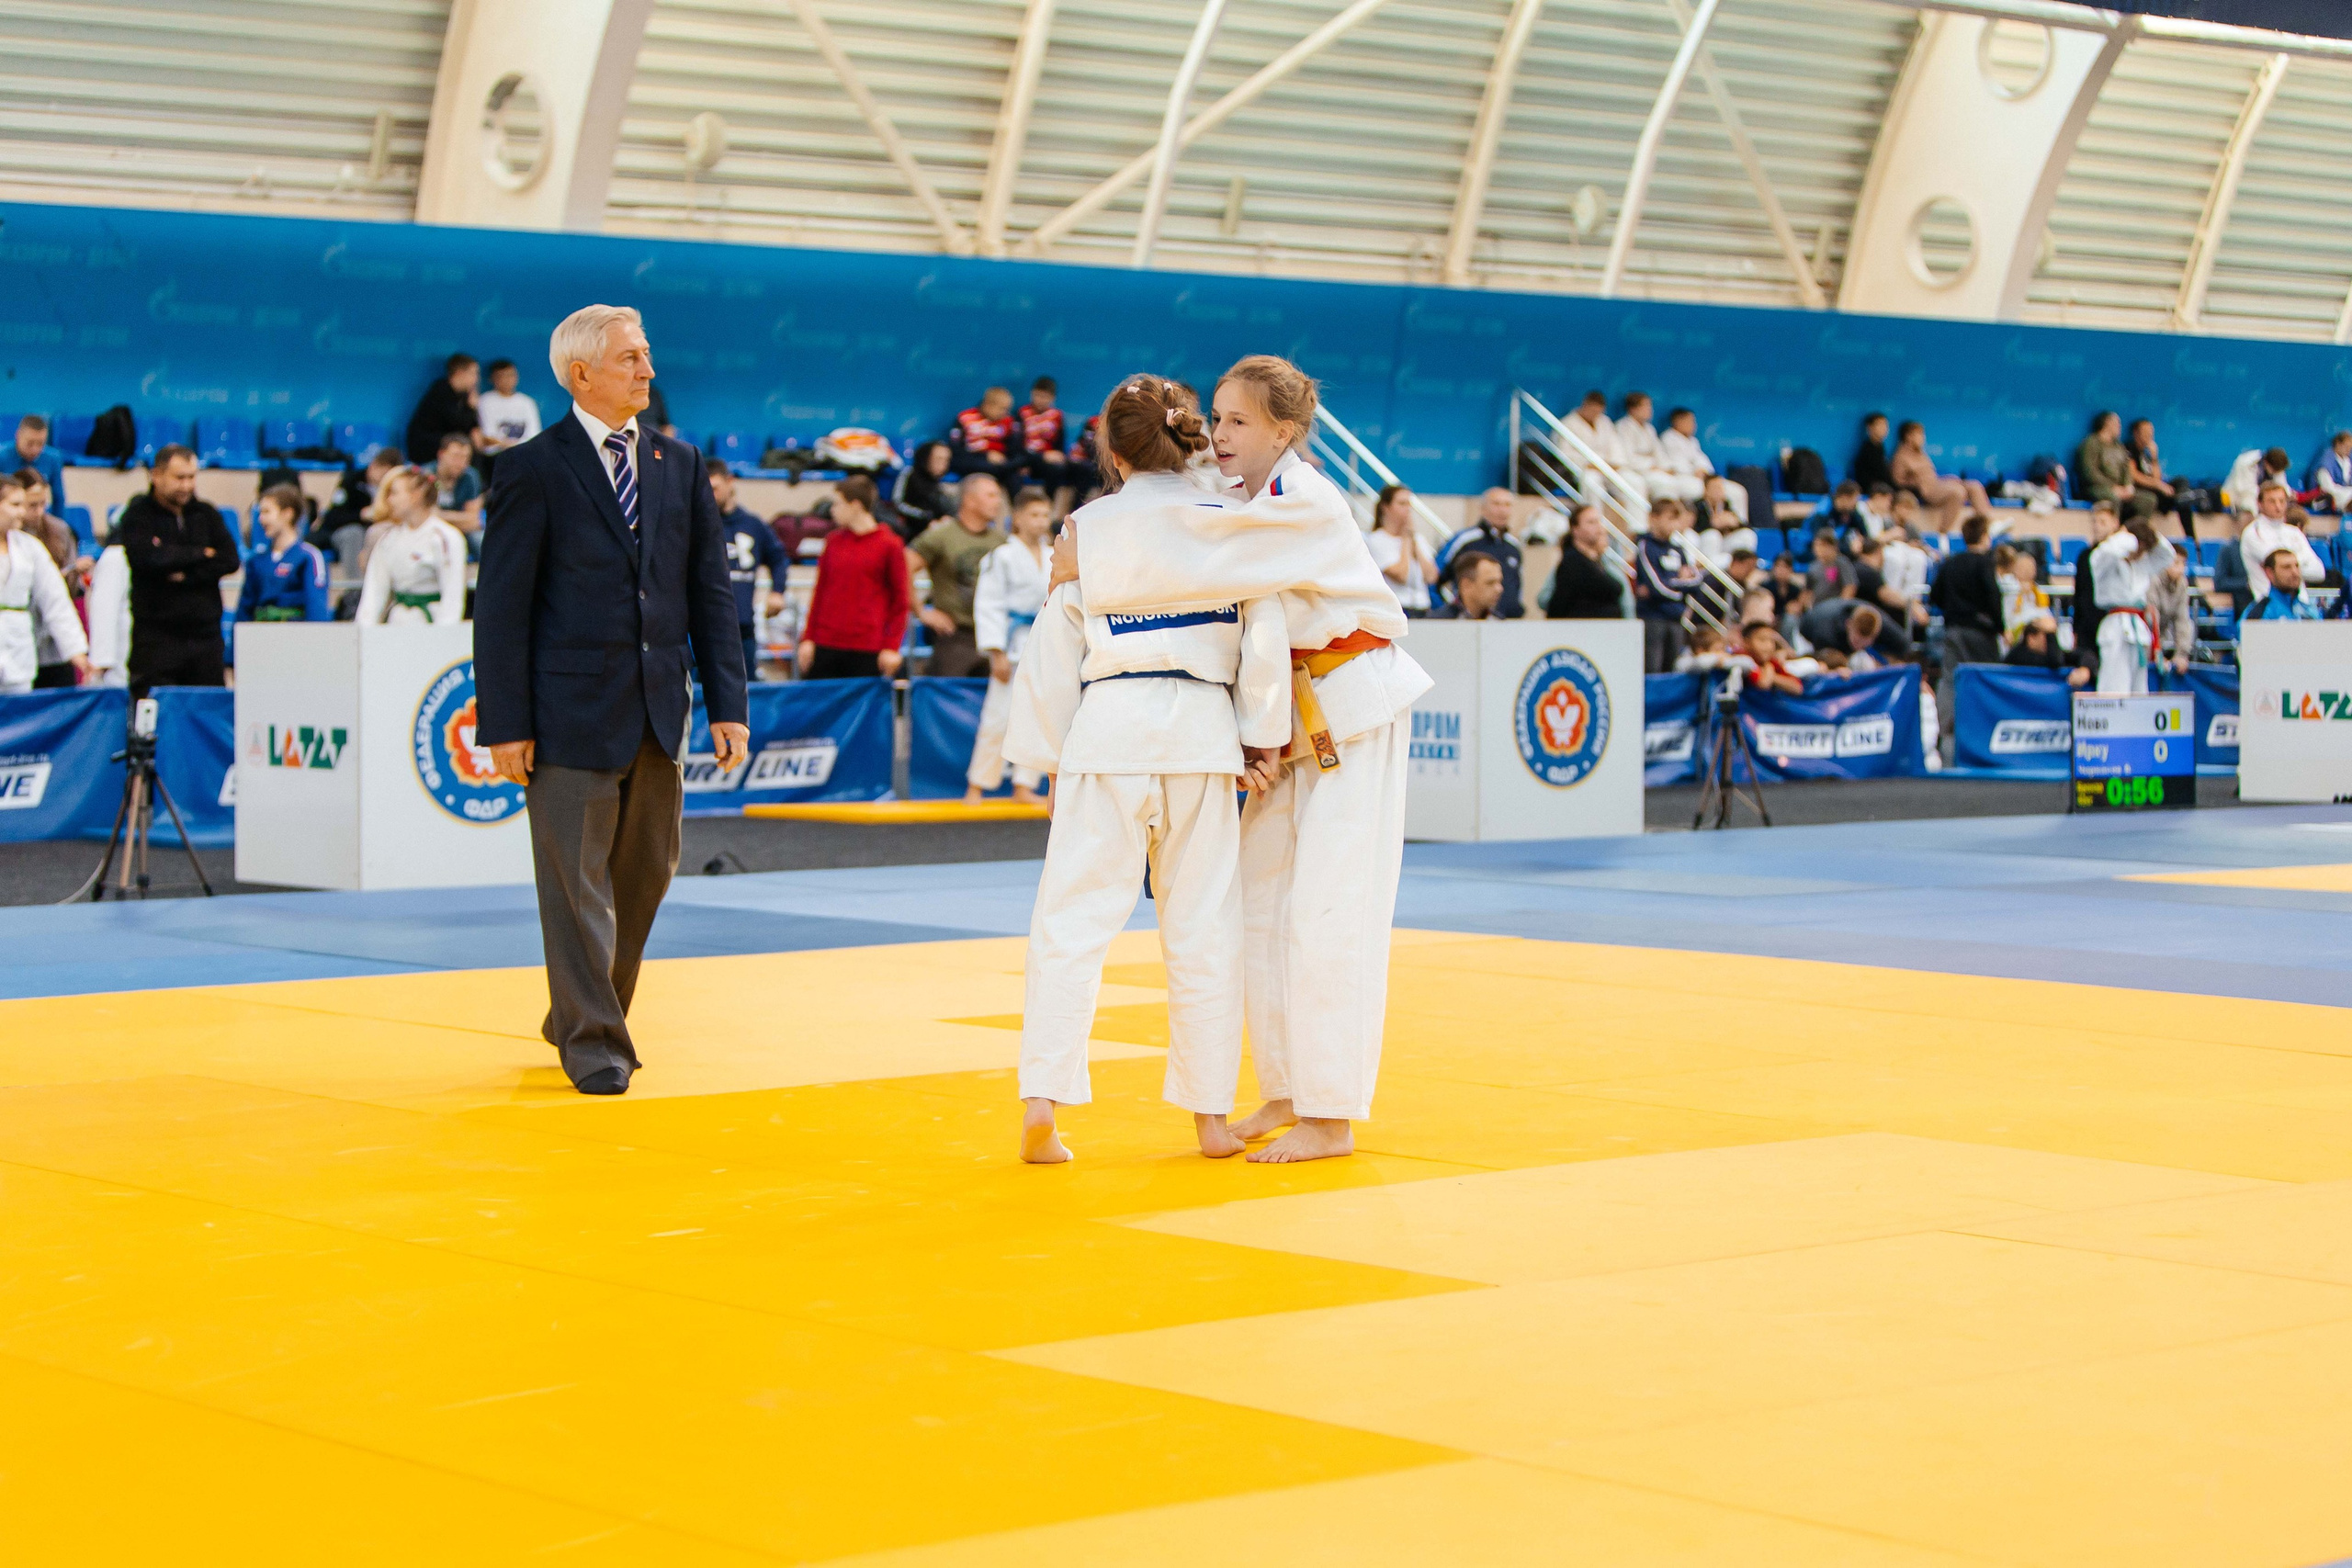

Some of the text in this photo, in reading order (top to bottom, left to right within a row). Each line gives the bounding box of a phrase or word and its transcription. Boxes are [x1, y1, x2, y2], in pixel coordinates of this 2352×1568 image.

[2282, 691, 2352, 720] LATA
[2154, 711, 2167, 731] 0
[2154, 739, 2168, 763] 0
[756, 756, 823, 780] LINE
[2106, 775, 2165, 807] 0:56
